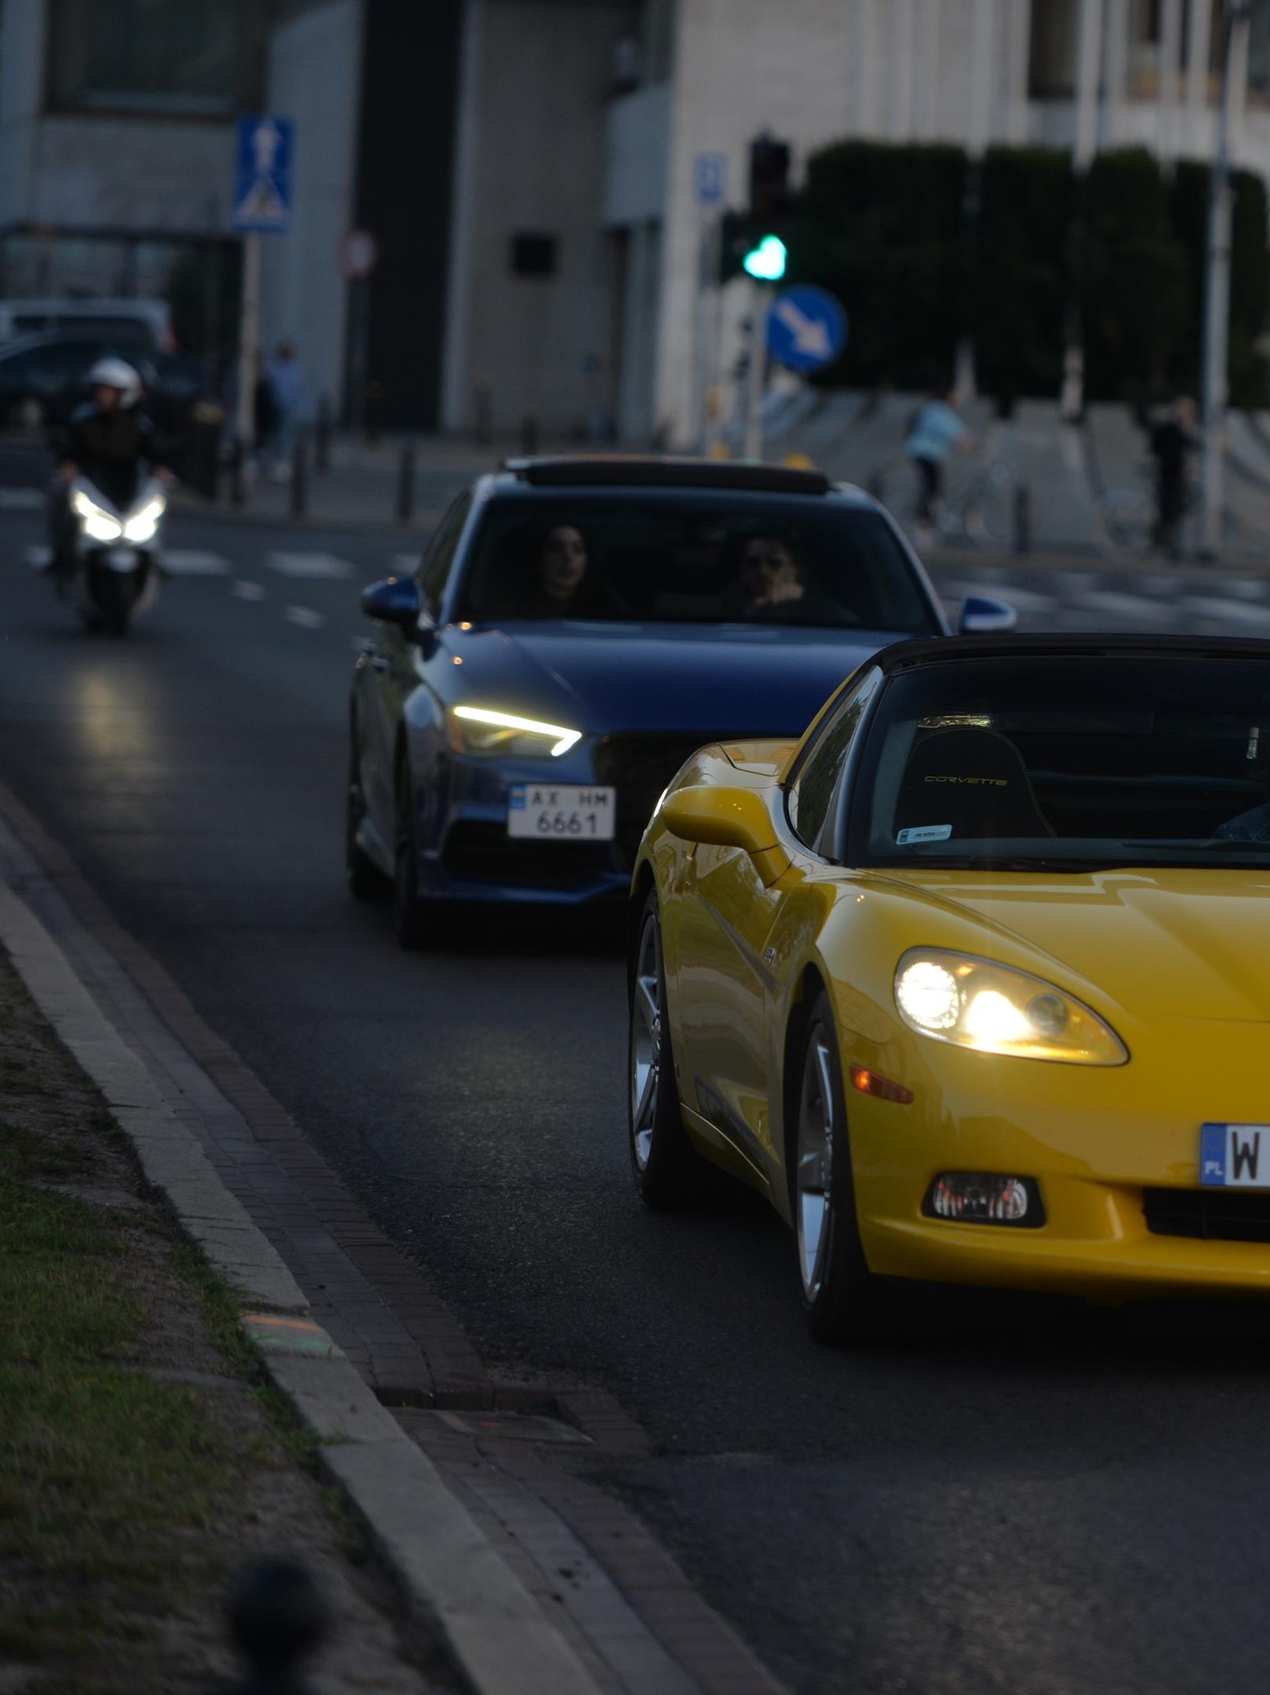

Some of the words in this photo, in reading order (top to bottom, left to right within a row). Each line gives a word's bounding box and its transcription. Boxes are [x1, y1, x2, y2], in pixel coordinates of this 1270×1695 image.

[924, 775, 1008, 786] CORVETTE
[537, 810, 596, 834] 6661
[1232, 1131, 1260, 1179] W
[1204, 1160, 1223, 1176] PL
